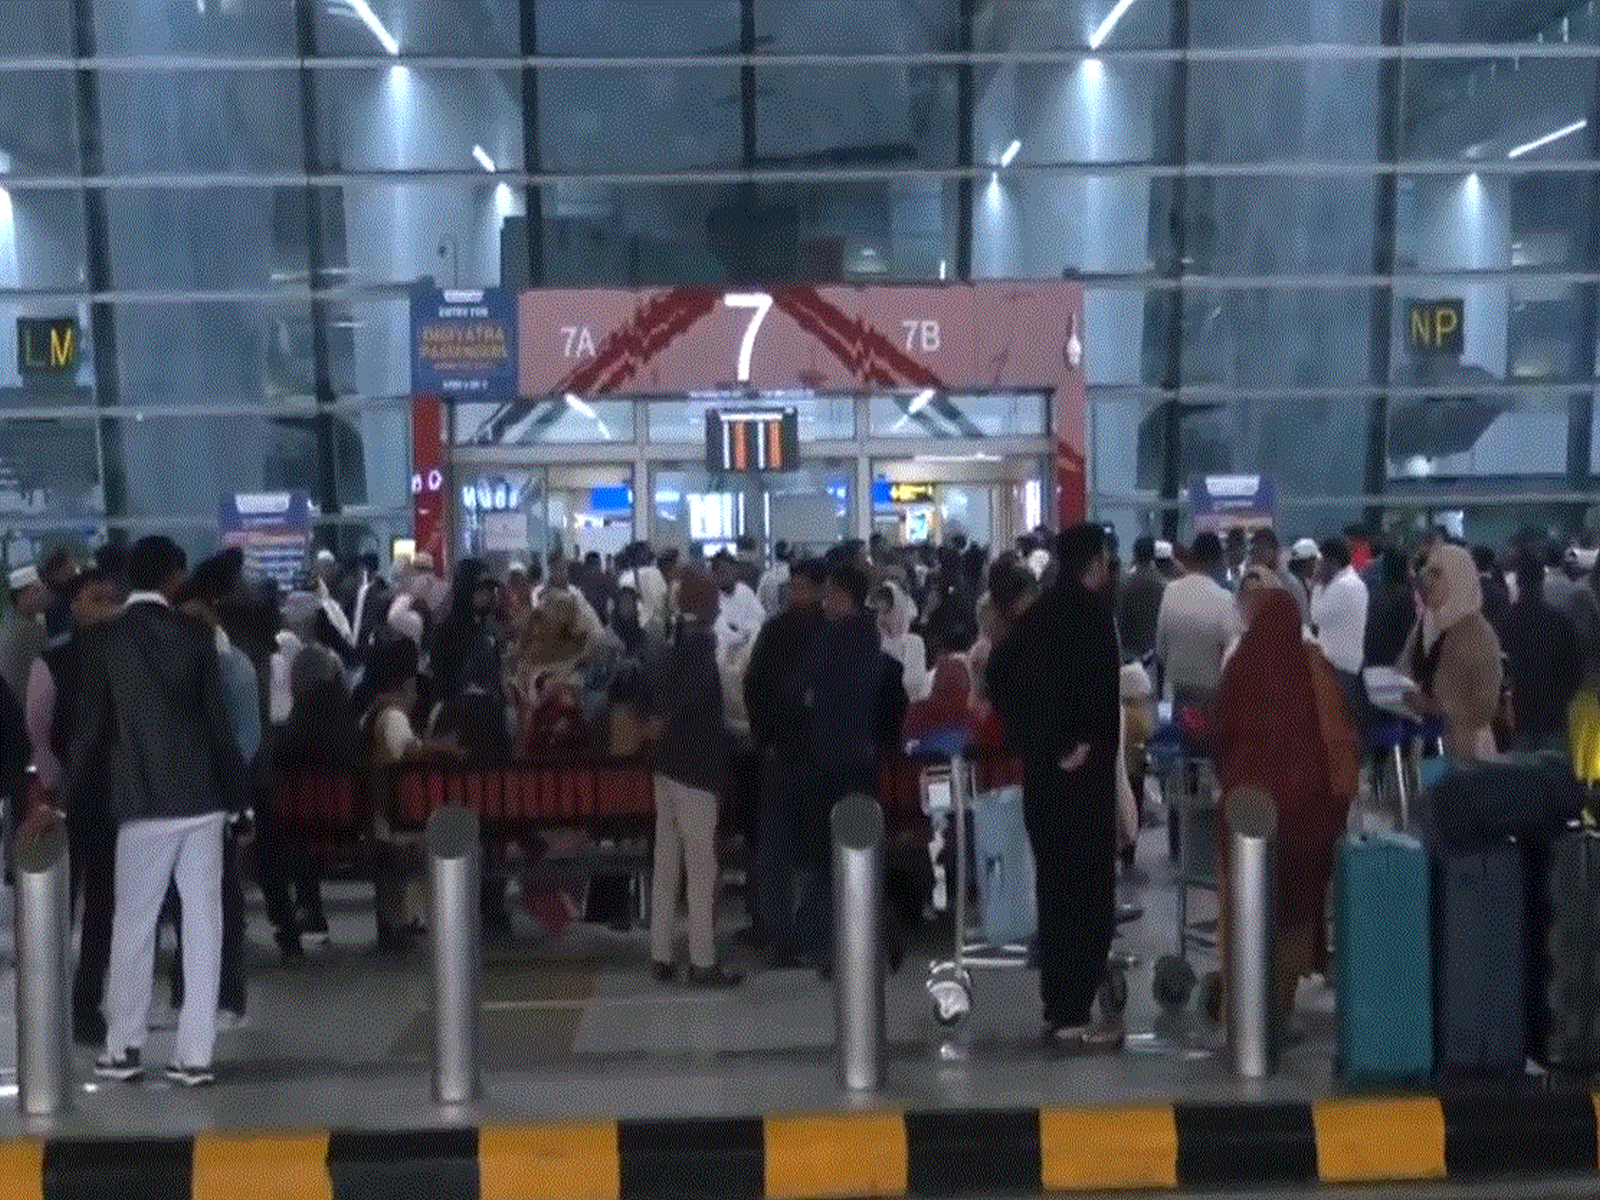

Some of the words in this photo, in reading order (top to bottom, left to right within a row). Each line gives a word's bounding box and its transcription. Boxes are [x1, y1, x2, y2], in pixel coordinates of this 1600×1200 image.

[560, 326, 596, 358] 7A
[723, 293, 773, 381] 7
[902, 320, 940, 351] 7B
